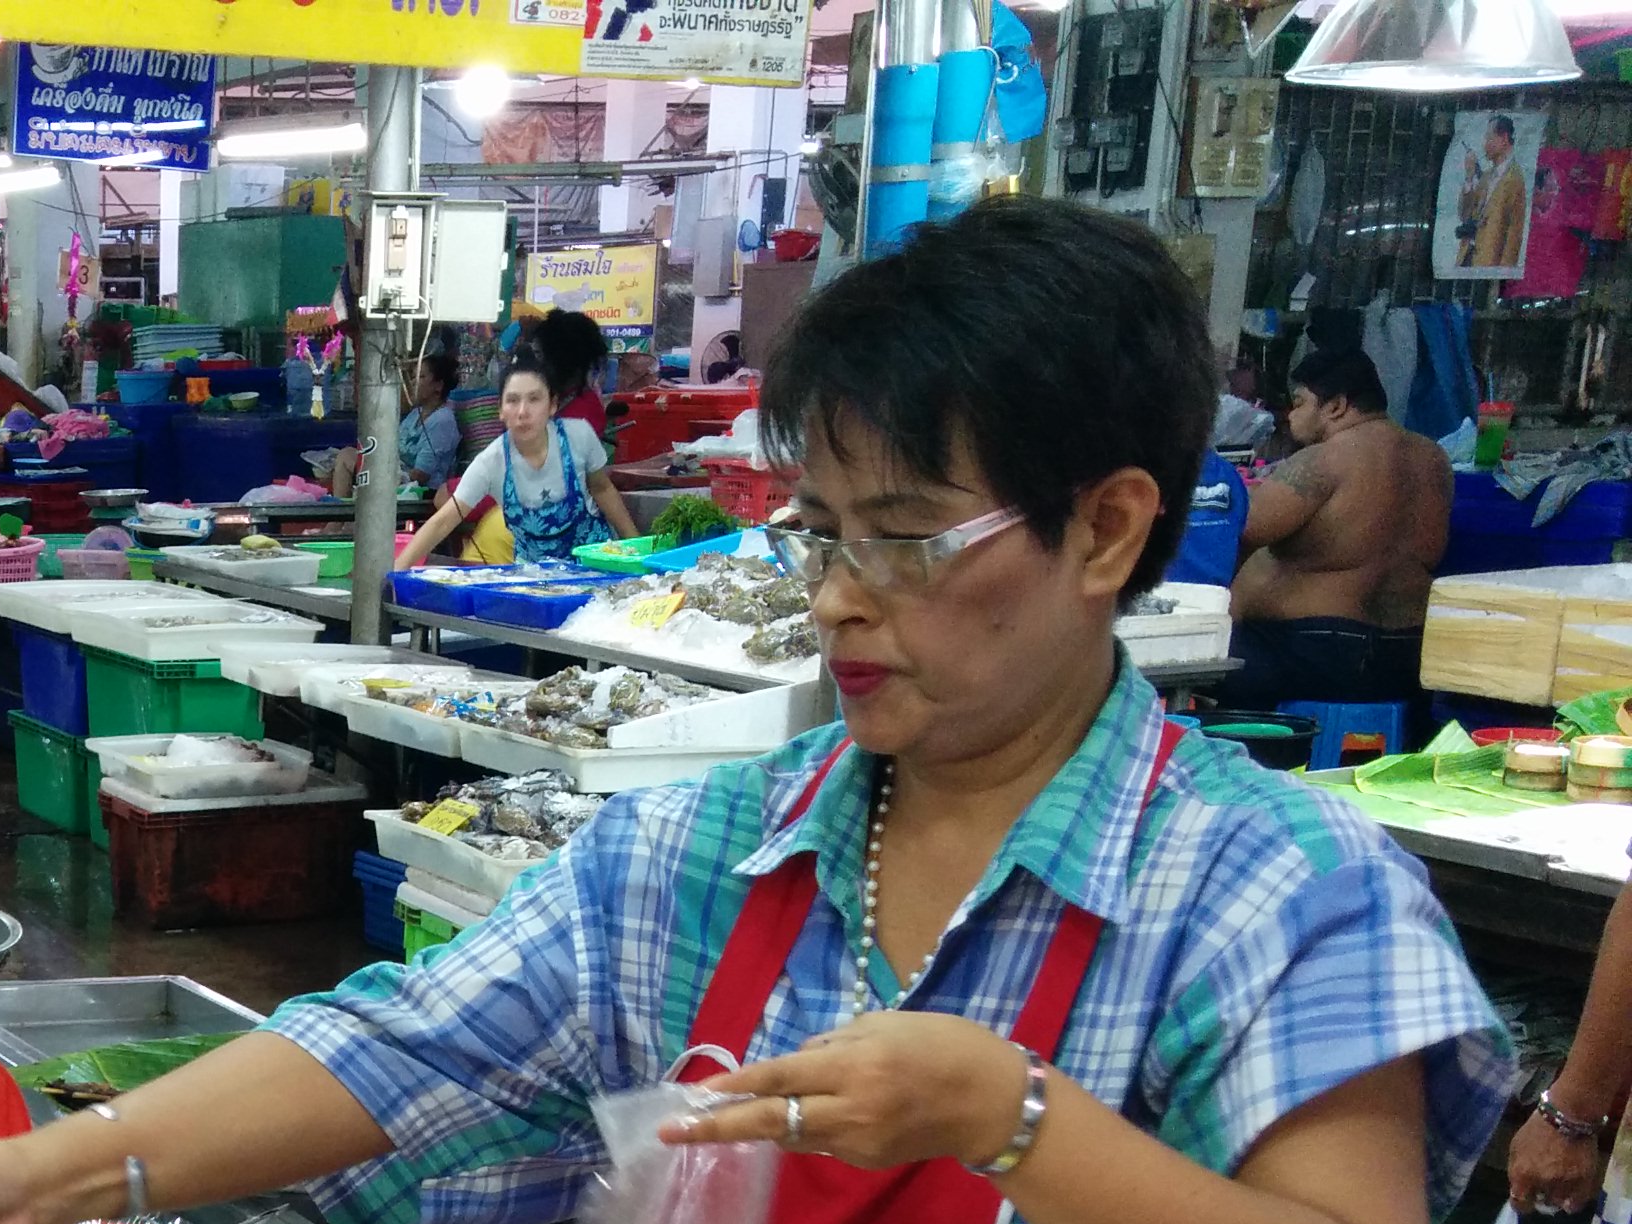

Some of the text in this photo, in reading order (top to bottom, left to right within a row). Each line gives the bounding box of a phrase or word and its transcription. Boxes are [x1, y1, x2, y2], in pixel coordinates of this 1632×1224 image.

[762, 61, 784, 73] 1205
[31, 82, 204, 123] เครื่องดื่ม ทุกชนิด
[540, 250, 612, 278] ร้านสมใจ
